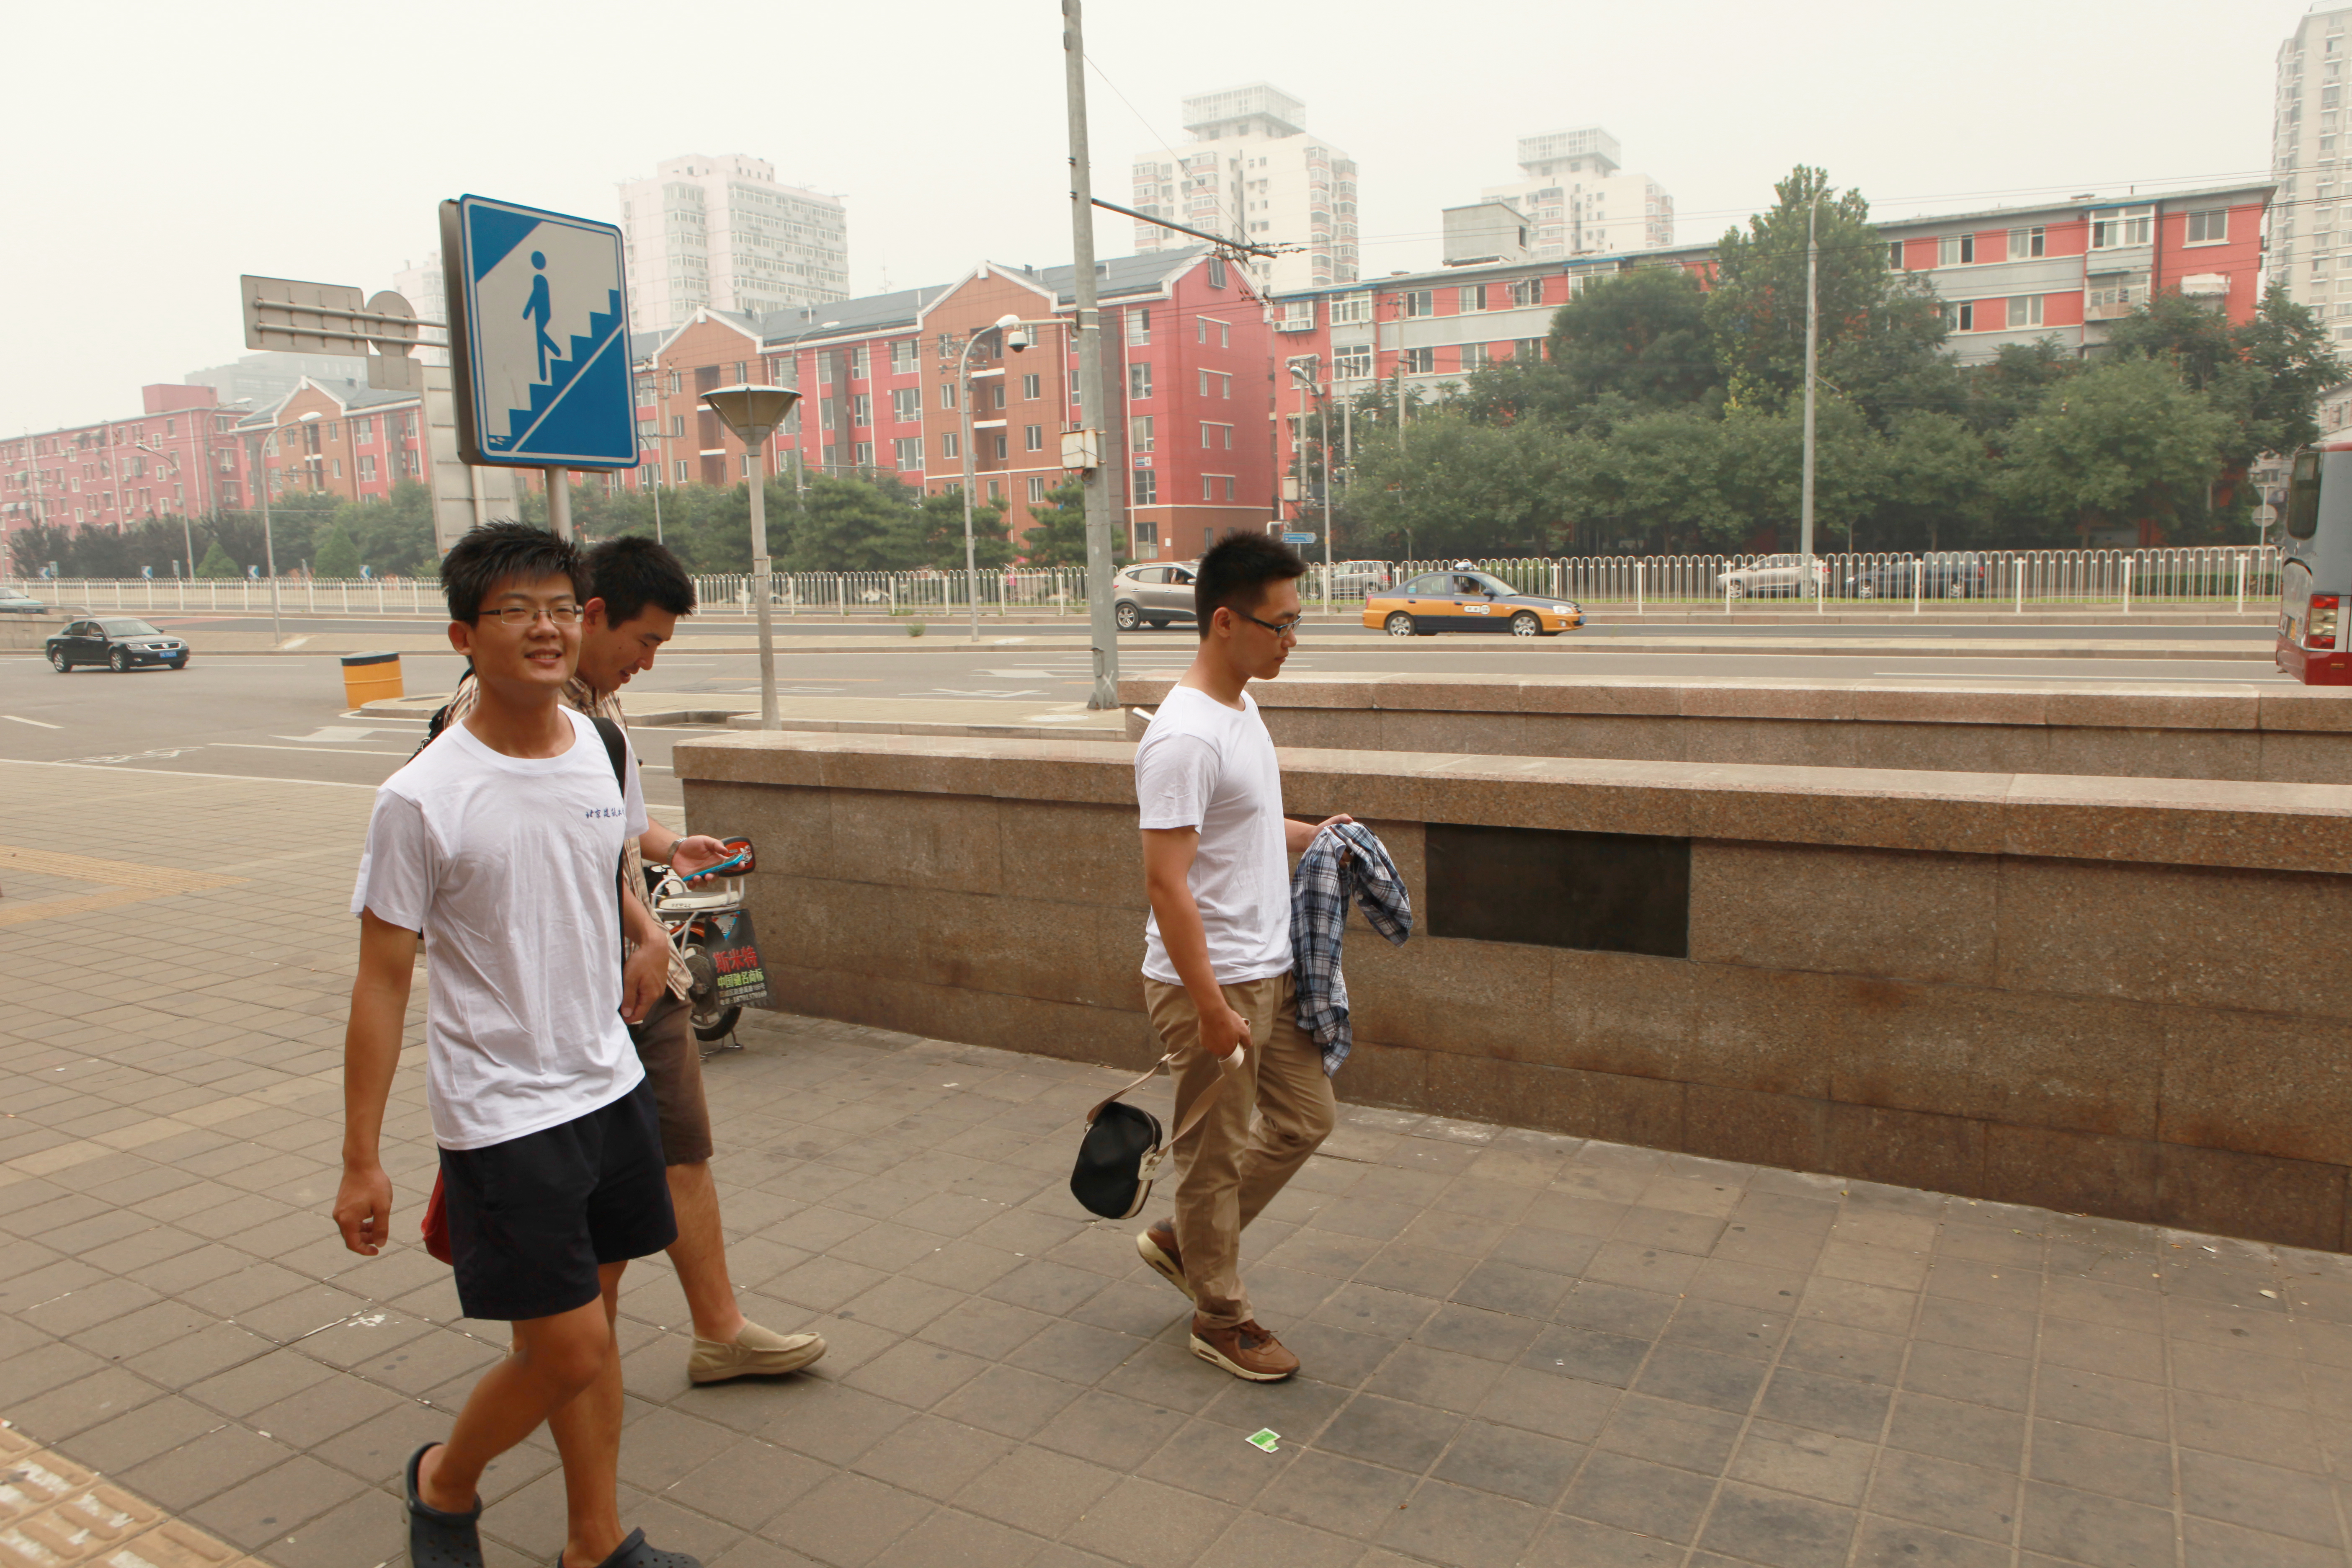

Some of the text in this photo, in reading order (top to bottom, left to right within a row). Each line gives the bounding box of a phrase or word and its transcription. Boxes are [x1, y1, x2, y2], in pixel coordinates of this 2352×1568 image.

[713, 945, 758, 973] 斯米特
[717, 968, 764, 989] 中国驰名商标
